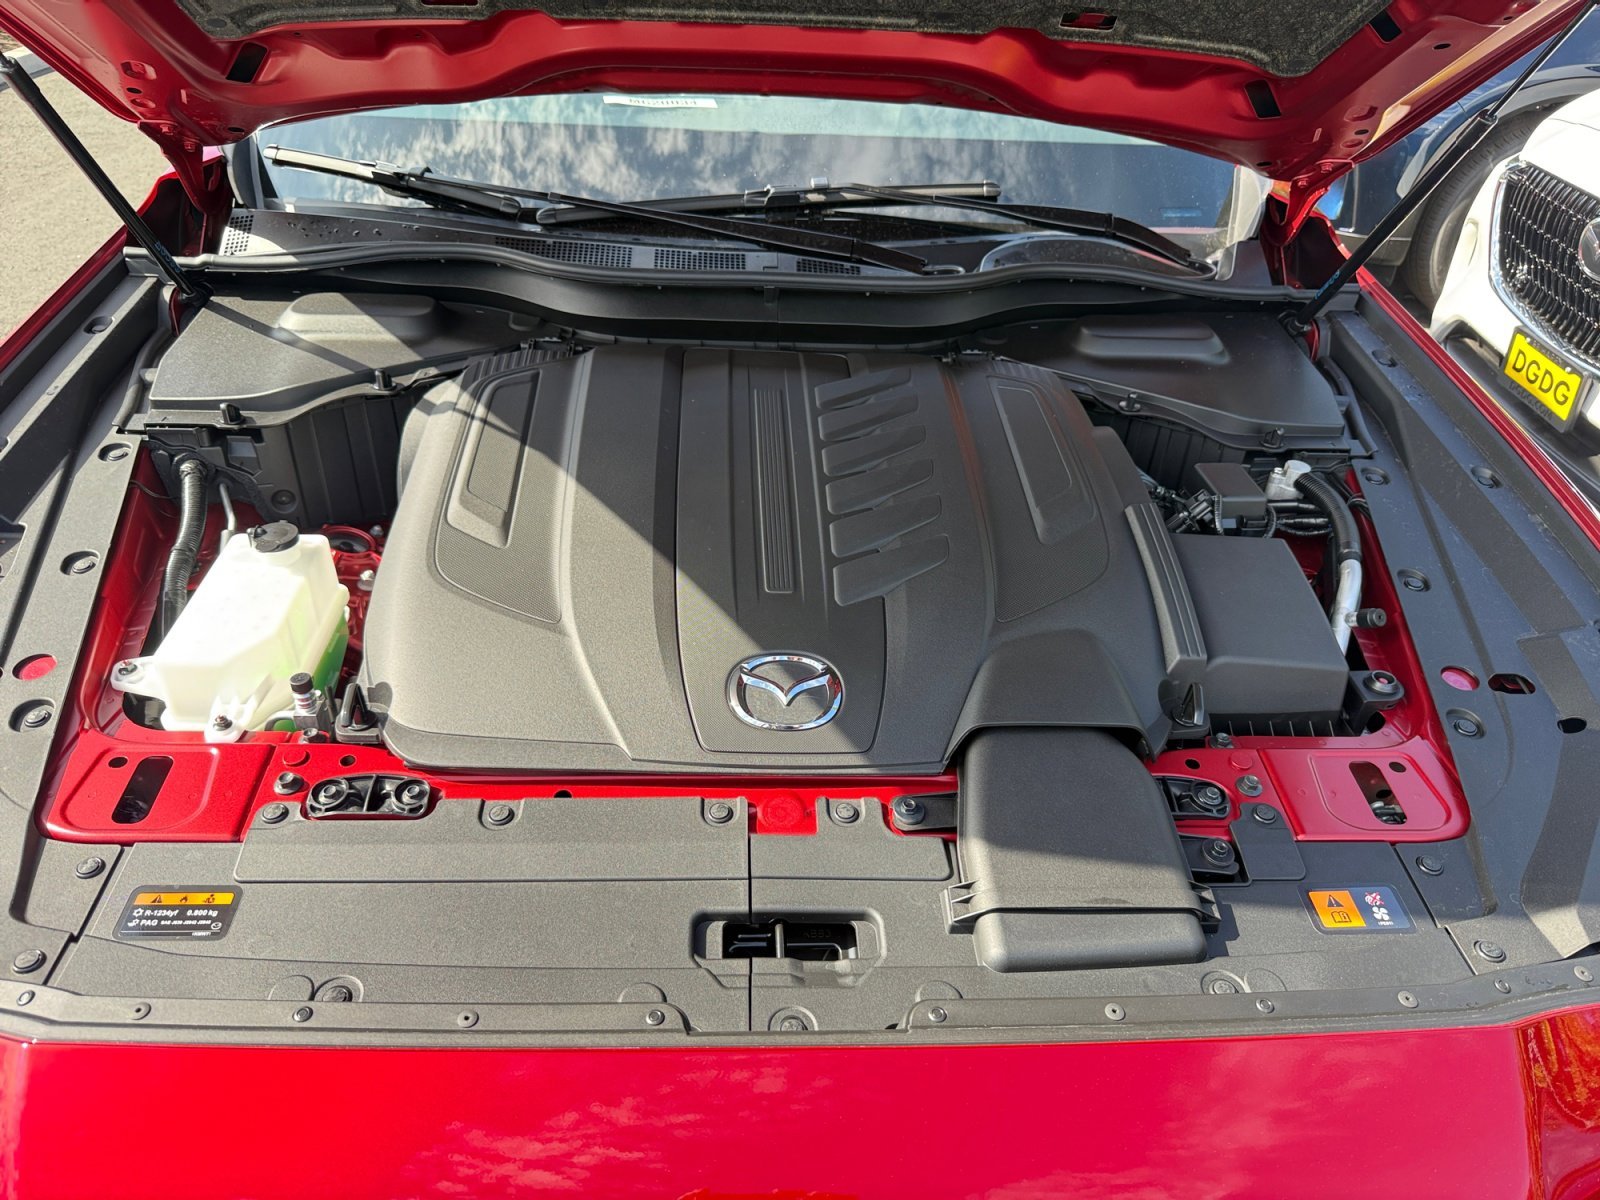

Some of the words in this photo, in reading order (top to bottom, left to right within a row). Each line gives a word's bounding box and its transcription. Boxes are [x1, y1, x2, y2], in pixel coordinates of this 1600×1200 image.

[1512, 348, 1571, 406] DGDG
[144, 909, 180, 918] R-1234yf
[186, 909, 208, 917] 0.800
[208, 909, 219, 918] kg
